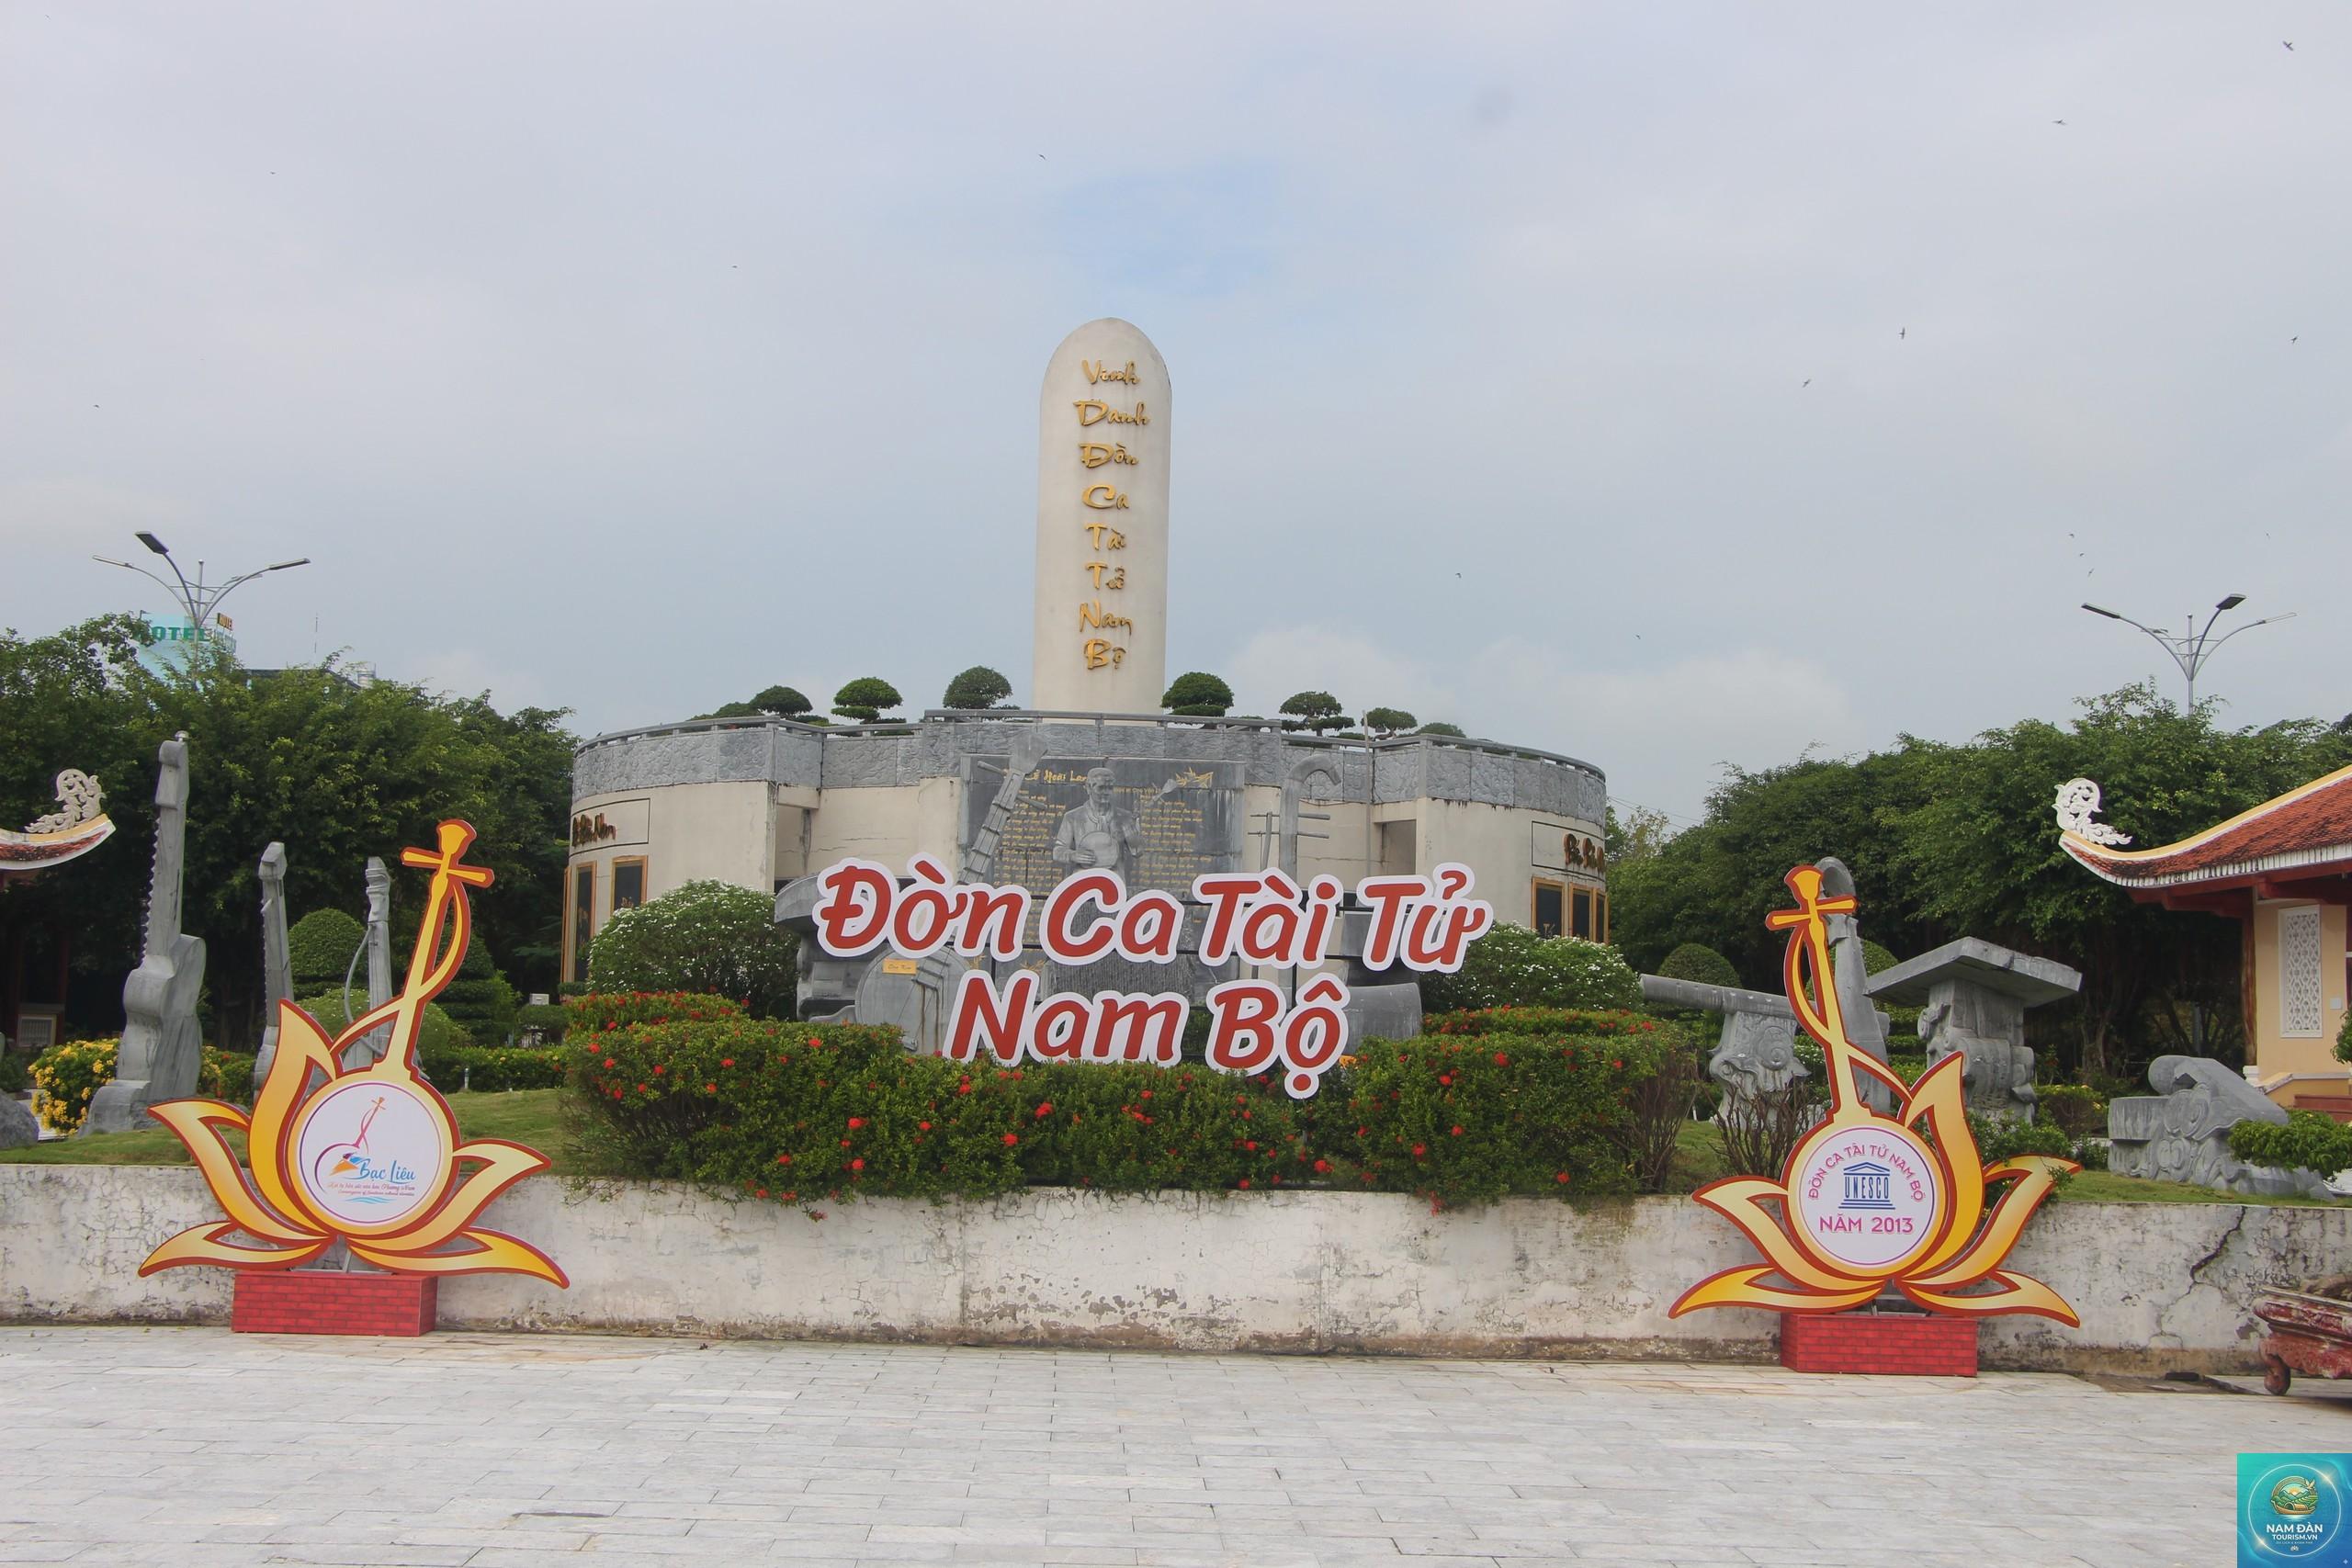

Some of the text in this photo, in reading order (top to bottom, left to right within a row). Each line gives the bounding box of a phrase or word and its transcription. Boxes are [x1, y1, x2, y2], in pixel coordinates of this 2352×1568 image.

[1081, 360, 1140, 385] Vinh
[1073, 399, 1150, 427] Danh
[1081, 484, 1130, 510] Ca
[1084, 522, 1126, 551] Tài
[1079, 599, 1133, 637] Nam
[151, 625, 211, 642] OTEL
[1083, 638, 1126, 671] Bộ
[821, 862, 1486, 965] Đờn Ca Tài Tử
[951, 978, 1341, 1091] Nam Bộ
[358, 1157, 416, 1185] Bạc Liêu
[1825, 1152, 1846, 1169] CA
[1844, 1142, 1866, 1159] TÀI
[1869, 1143, 1890, 1158] TỬ
[1889, 1153, 1916, 1179] NAM
[1909, 1179, 1927, 1203] BỘ
[1844, 1176, 1890, 1198] UNESCO
[1819, 1213, 1914, 1234] NĂM 2013
